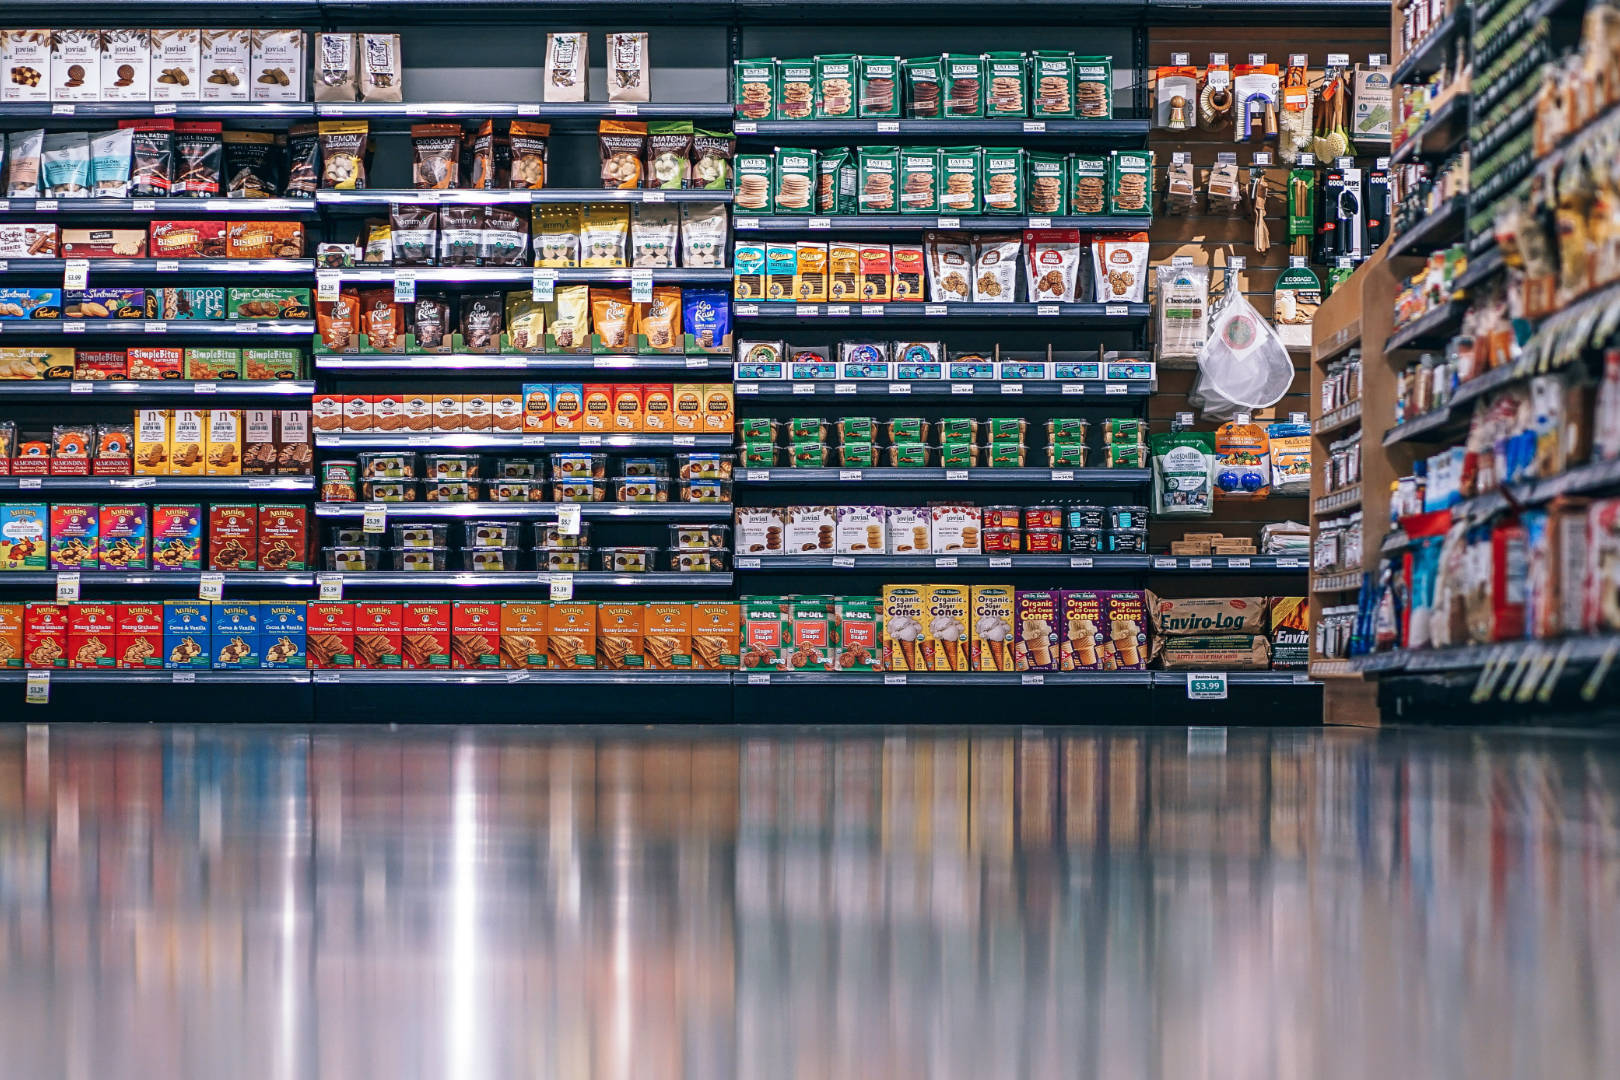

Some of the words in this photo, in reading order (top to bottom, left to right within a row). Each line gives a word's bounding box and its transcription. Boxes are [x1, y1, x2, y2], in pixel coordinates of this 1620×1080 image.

[15, 46, 36, 55] jovial
[65, 46, 87, 55] jovial
[115, 46, 136, 55] jovial
[164, 46, 186, 54] jovial
[215, 46, 236, 54] jovial
[265, 46, 286, 54] jovial
[694, 138, 729, 146] MATCHA
[157, 235, 198, 246] BISCOTTI
[233, 236, 273, 246] BISCOTTI
[376, 301, 388, 310] Go
[421, 301, 433, 309] Go
[473, 302, 486, 311] Go
[699, 301, 711, 310] Go
[372, 309, 392, 322] Raw
[418, 307, 438, 319] Raw
[469, 311, 489, 322] Raw
[695, 310, 715, 322] Raw
[80, 352, 124, 363] SimpleBites
[134, 350, 178, 360] SimpleBites
[194, 350, 237, 360] SimpleBites
[250, 350, 293, 360] SimpleBites
[64, 508, 87, 516] Annie's
[111, 508, 134, 516] Annie's
[165, 509, 189, 517] Annie's
[222, 509, 246, 517] Annie's
[270, 509, 295, 518] Annie's
[890, 596, 920, 604] Organic
[932, 596, 962, 604] Organic
[978, 596, 1008, 604] Organic
[1022, 600, 1053, 608] Organic
[1068, 600, 1098, 608] Organic
[1110, 600, 1140, 608] Organic
[36, 606, 60, 615] Annie's
[81, 606, 106, 615] Annie's
[129, 606, 153, 615] Annie's
[175, 607, 199, 615] Annie's
[224, 607, 249, 615] Annie's
[272, 606, 297, 615] Annie's
[319, 606, 344, 615] Annie's
[367, 606, 391, 615] Annie's
[414, 606, 438, 615] Annie's
[465, 606, 488, 615] Annie's
[512, 606, 536, 615] Annie's
[560, 607, 584, 615] Annie's
[609, 607, 633, 616] Annie's
[656, 607, 680, 616] Annie's
[704, 606, 728, 616] Annie's
[888, 606, 920, 616] Cones
[930, 606, 963, 616] Cones
[977, 606, 1009, 616] Cones
[1021, 611, 1053, 620] Cones
[1066, 611, 1098, 620] Cones
[1109, 611, 1141, 620] Cones
[1160, 612, 1244, 630] Enviro-Log
